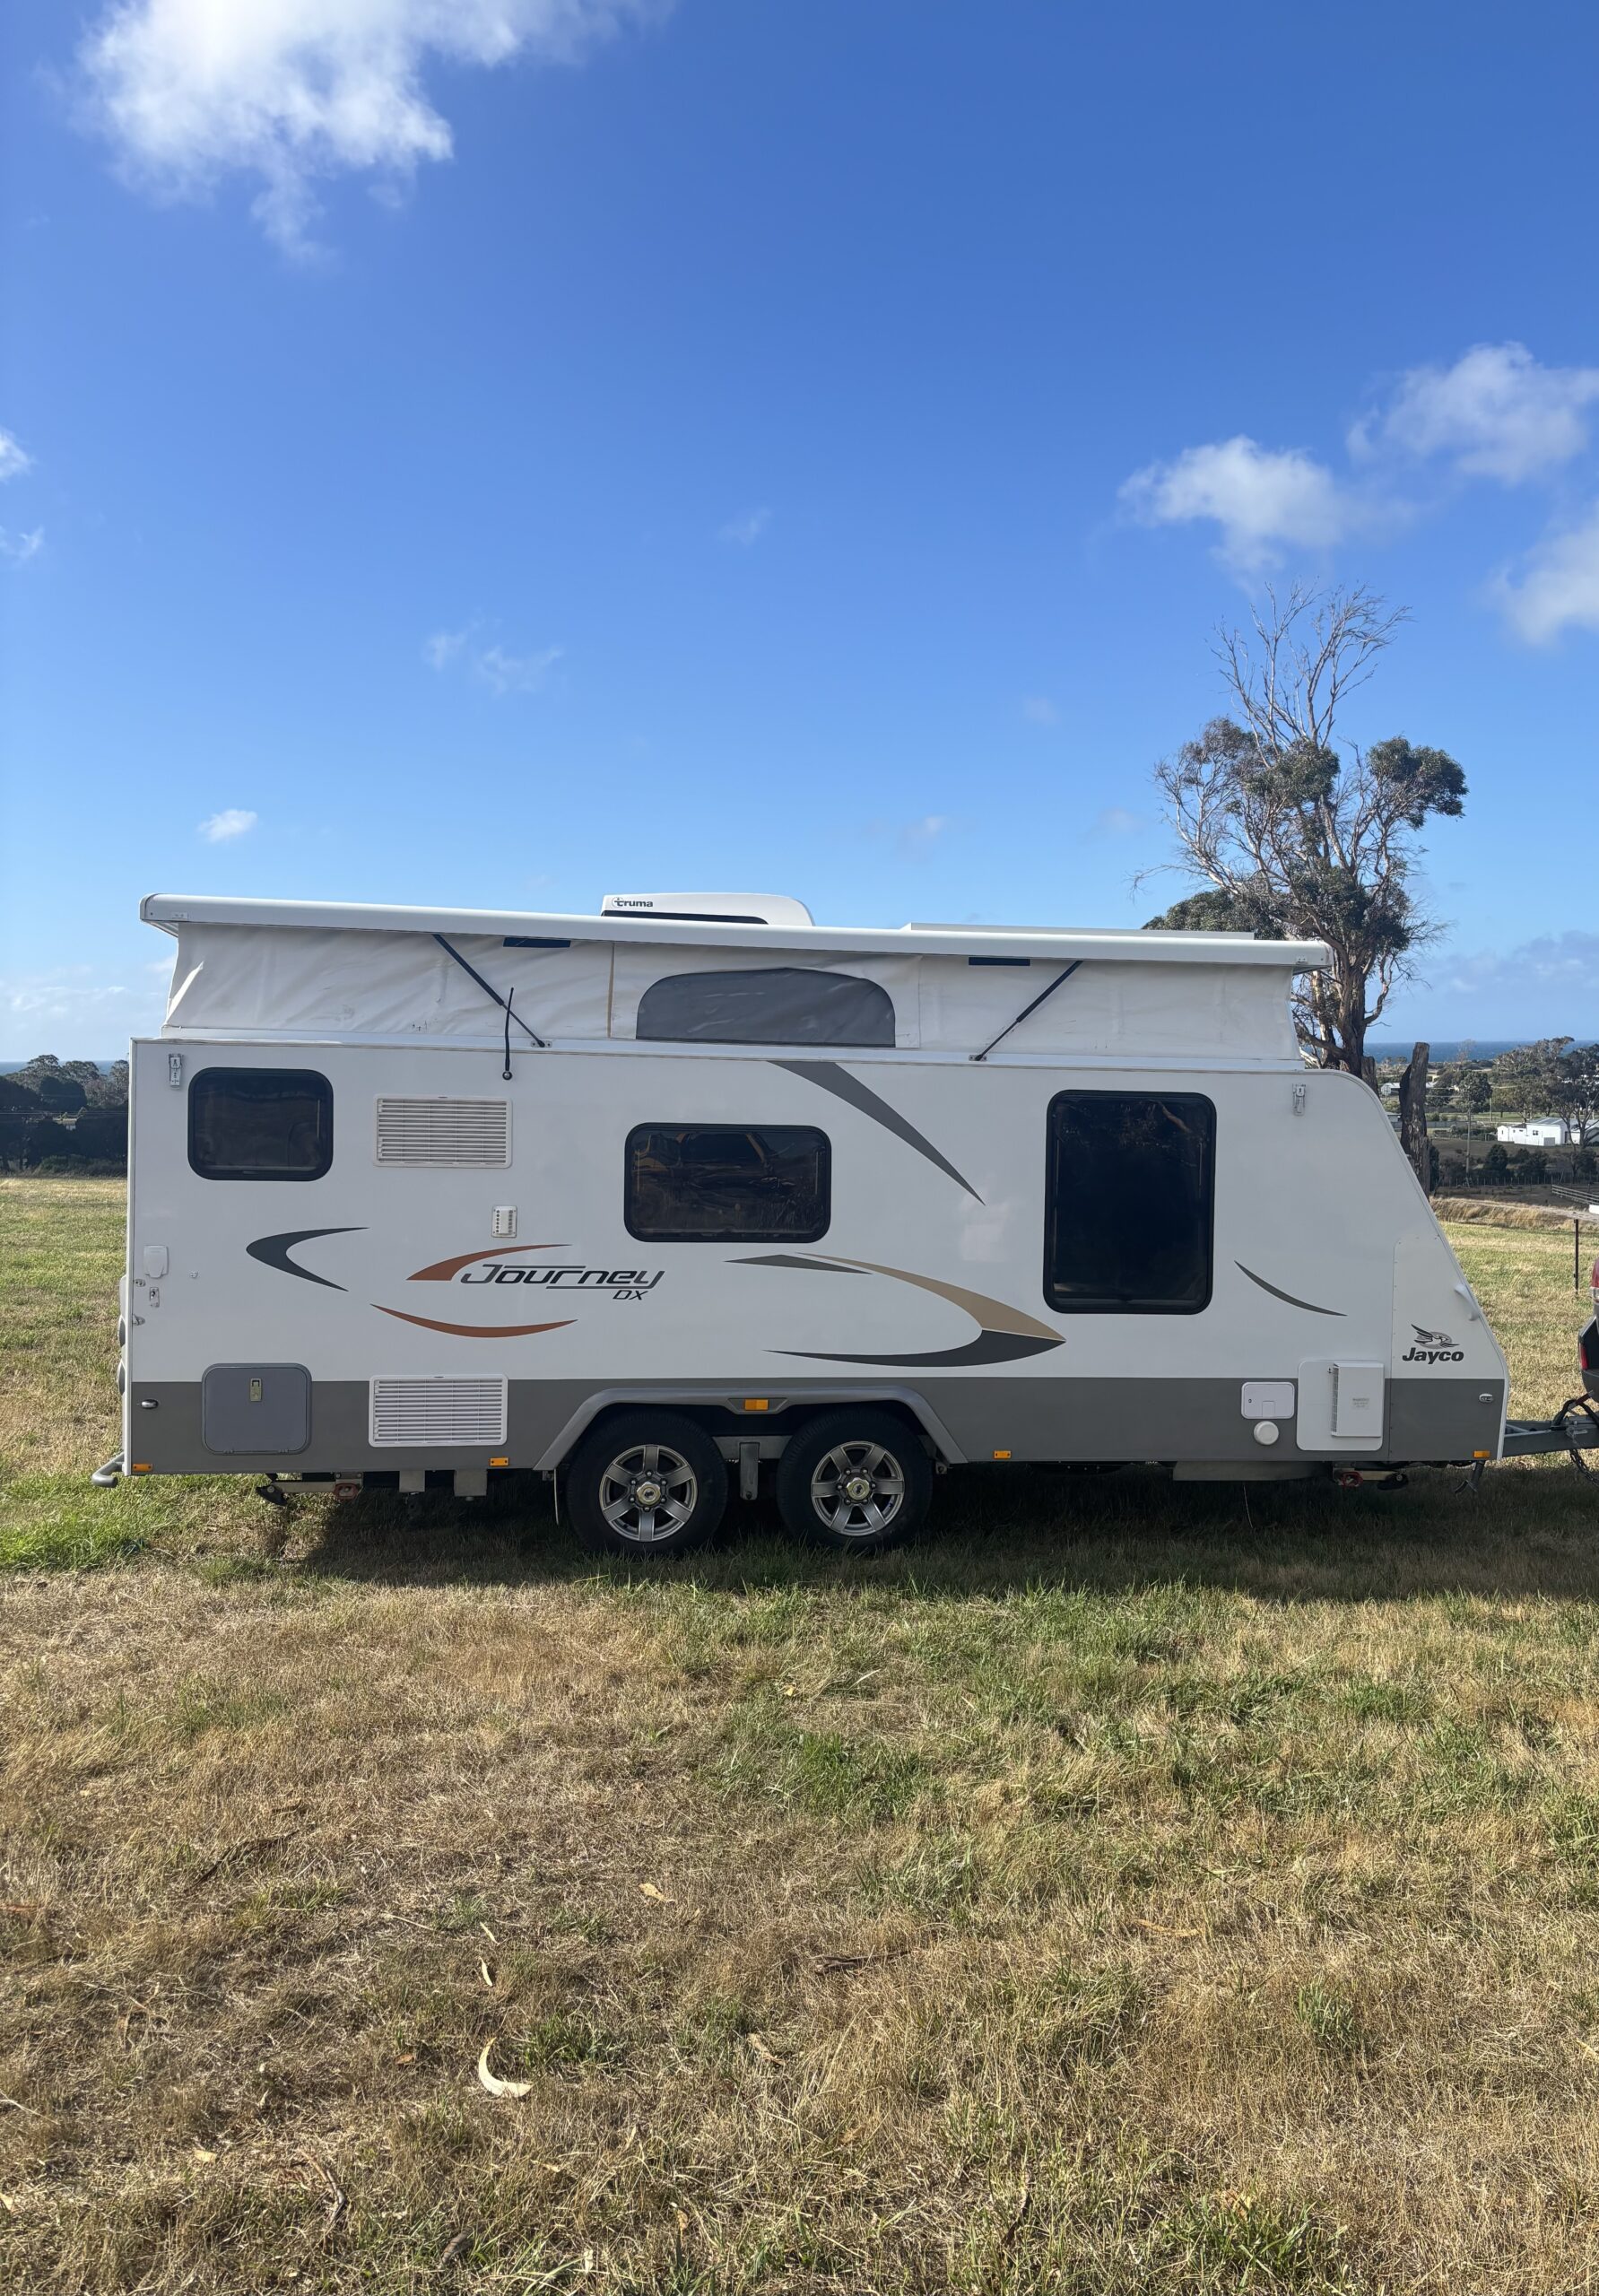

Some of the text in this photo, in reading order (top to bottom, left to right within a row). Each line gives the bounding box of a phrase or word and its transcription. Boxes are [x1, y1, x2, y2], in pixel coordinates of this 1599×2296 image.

[613, 898, 654, 908] truma
[460, 1264, 665, 1290] Journey
[613, 1290, 648, 1300] DX
[1402, 1347, 1464, 1365] Jayco
